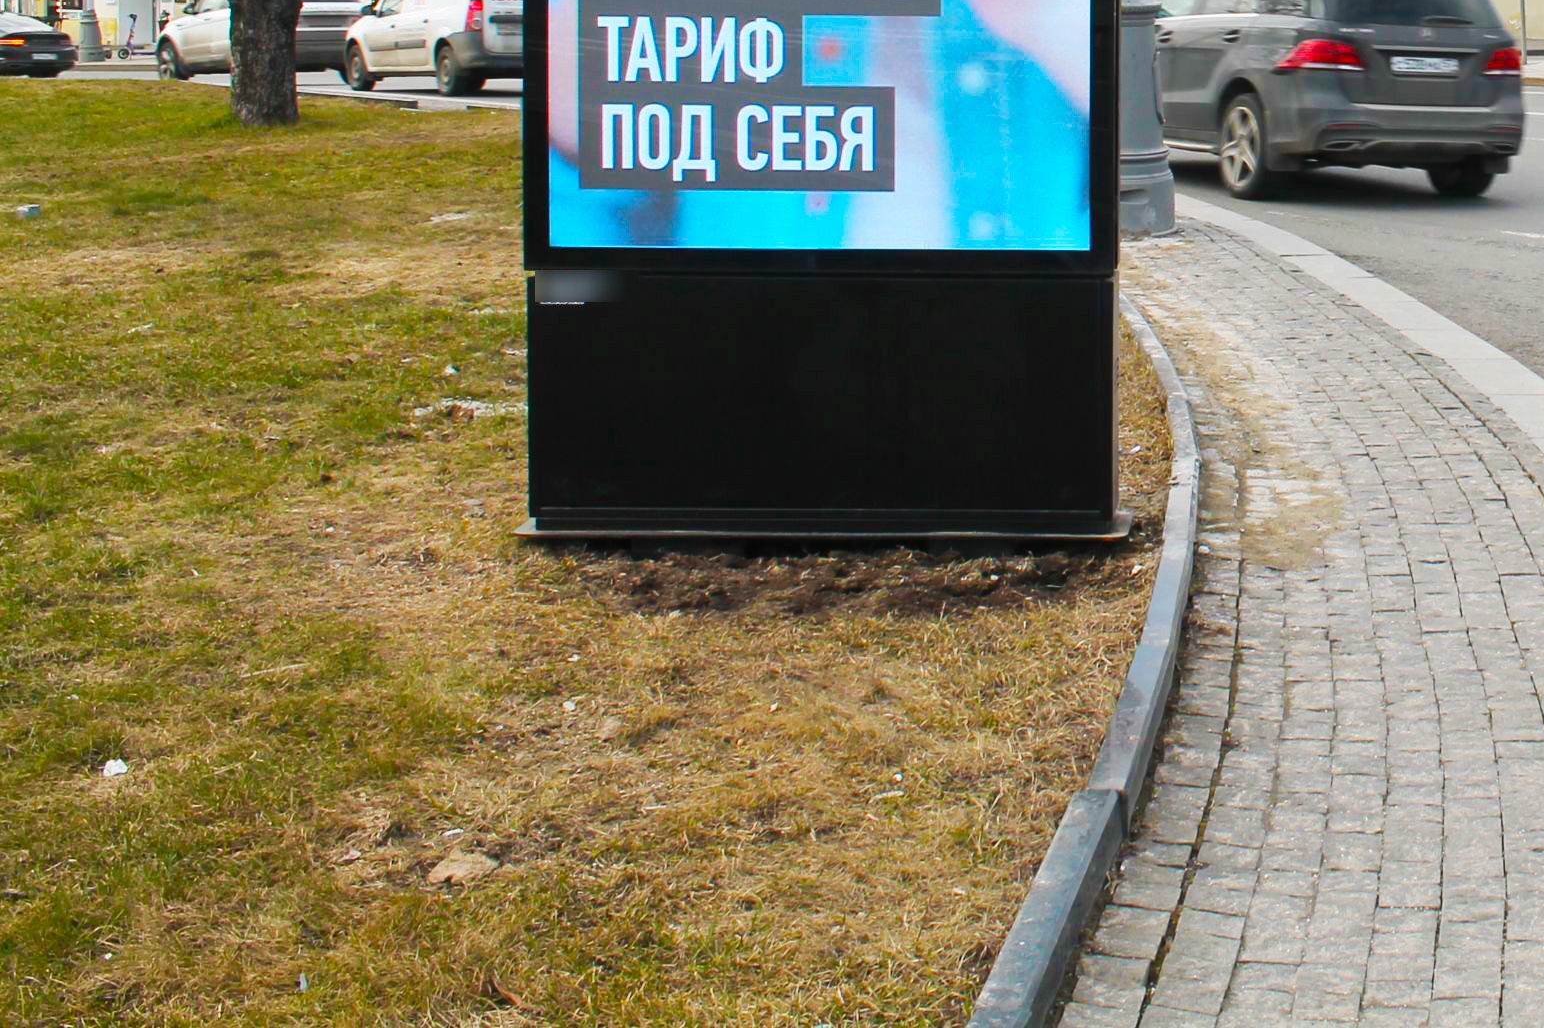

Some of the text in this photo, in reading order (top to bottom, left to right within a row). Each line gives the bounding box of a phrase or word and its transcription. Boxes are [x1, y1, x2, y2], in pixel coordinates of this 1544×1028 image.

[598, 16, 784, 84] ТАРИФ
[603, 104, 874, 182] ПОД СЕБЯ
